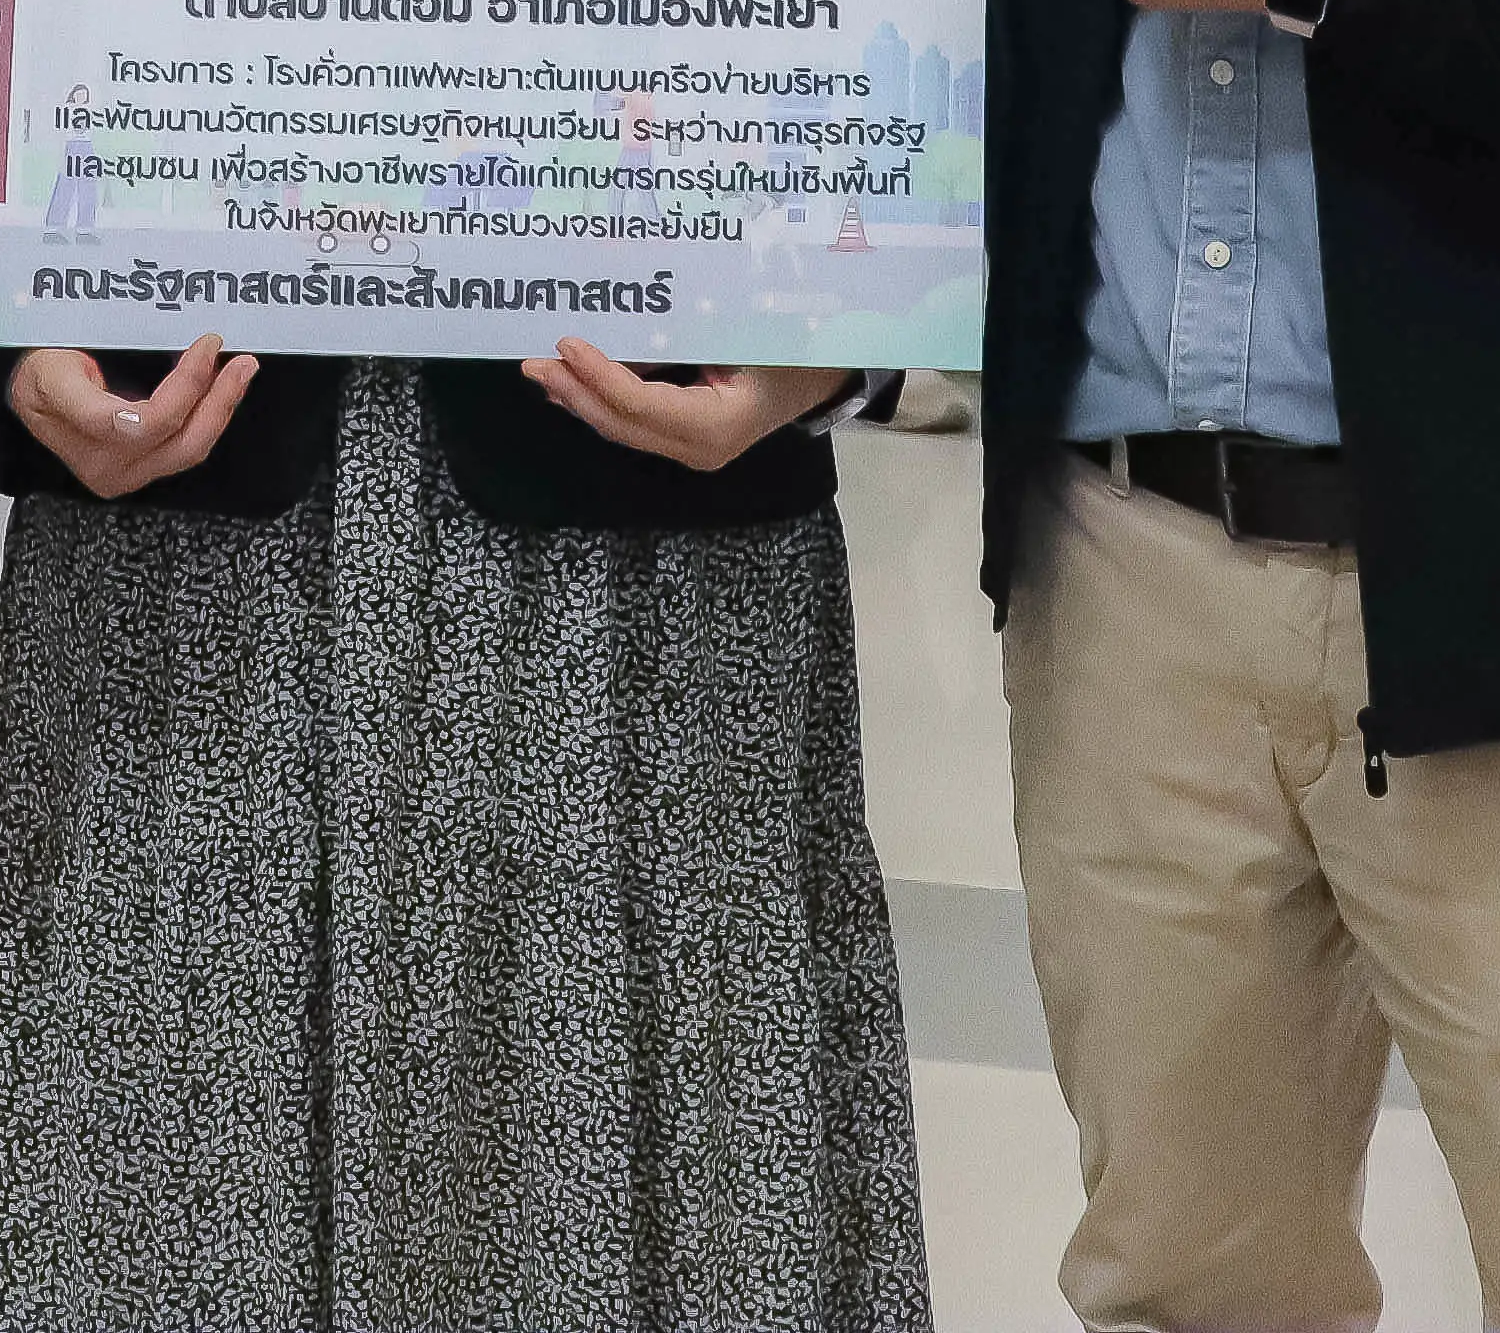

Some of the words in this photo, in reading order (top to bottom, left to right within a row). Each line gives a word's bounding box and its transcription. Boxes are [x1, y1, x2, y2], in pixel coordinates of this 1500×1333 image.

[108, 51, 236, 86] โครงการ
[55, 100, 621, 148] และพัฒนานวัตกรรมเศรษฐกิจหมุนเวียน
[66, 153, 200, 187] และชุมชน
[32, 258, 675, 315] คณะรัฐศาสตร์และสังคมศาสตร์
